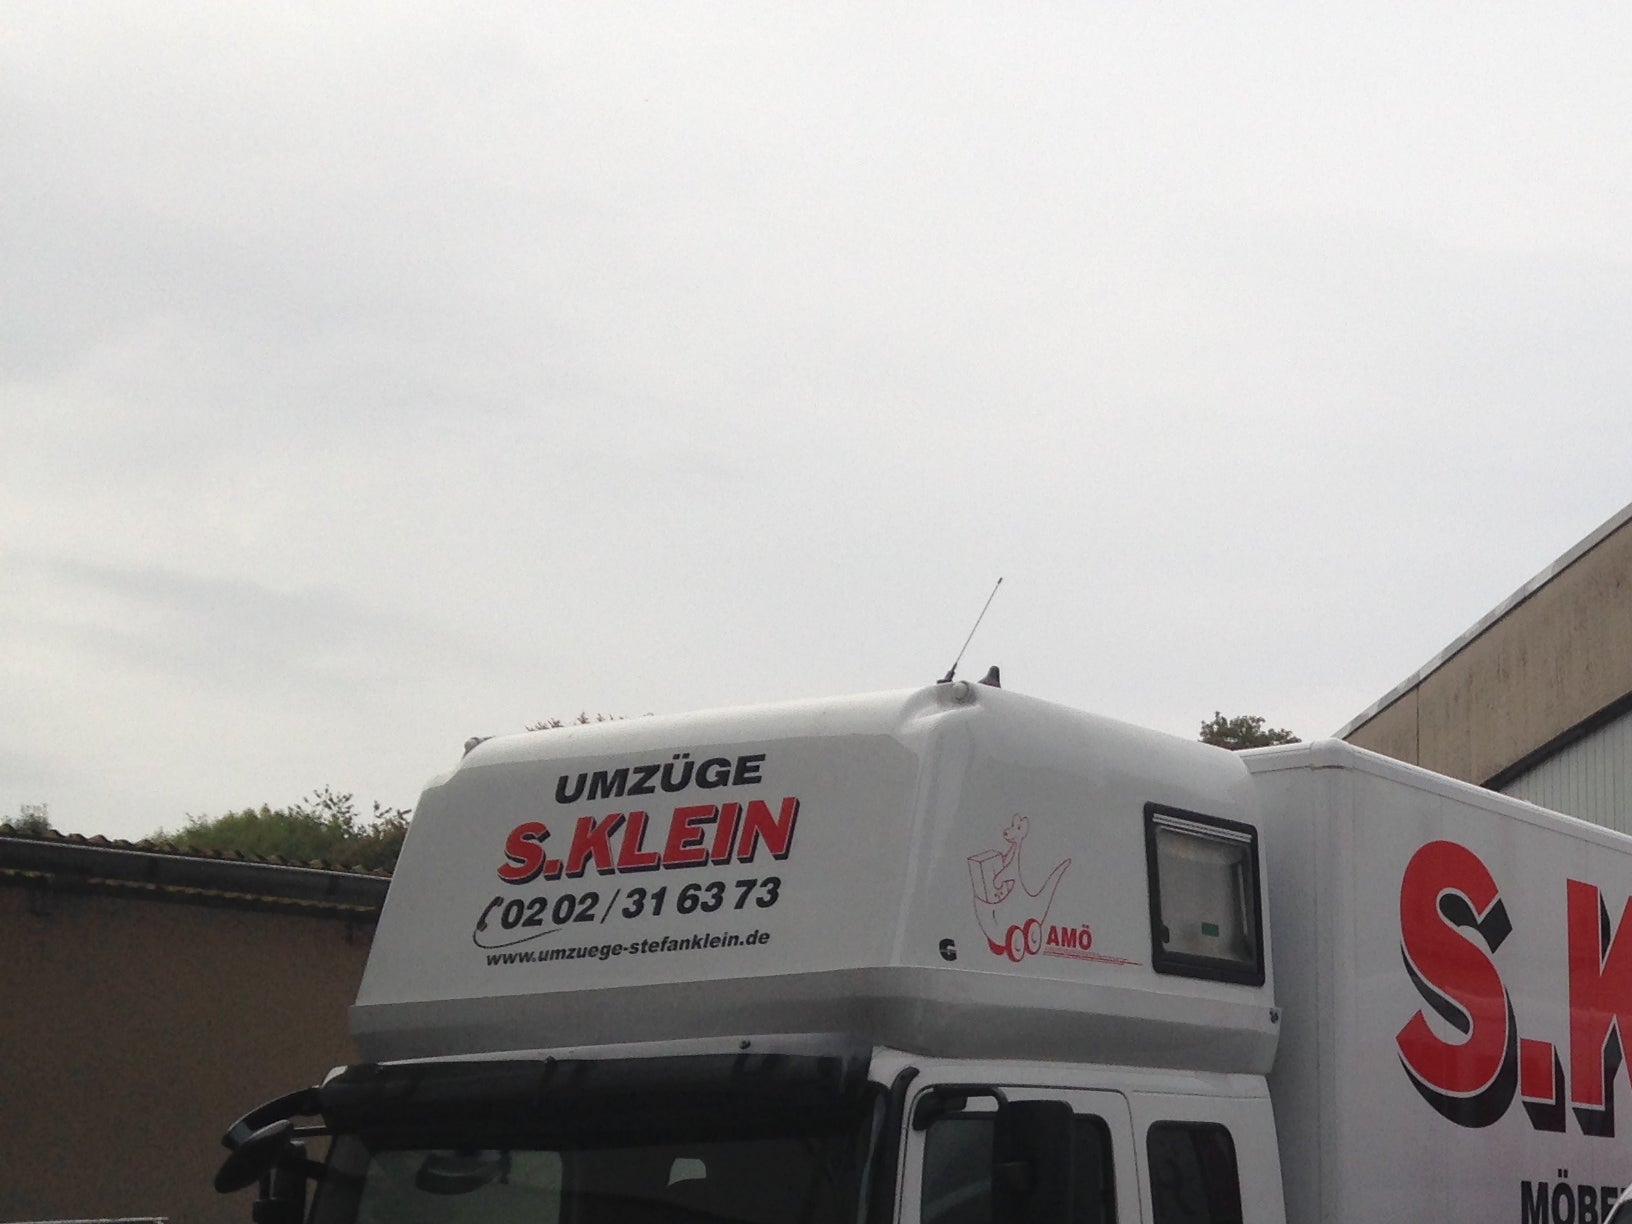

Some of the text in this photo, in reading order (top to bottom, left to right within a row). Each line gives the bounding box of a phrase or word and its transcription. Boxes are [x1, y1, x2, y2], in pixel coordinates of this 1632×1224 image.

[555, 753, 765, 804] UMZÜGE
[497, 797, 799, 885] S.KLEIN
[486, 930, 770, 966] www.umzuege-stefanklein.de
[1046, 925, 1093, 951] AMÖ
